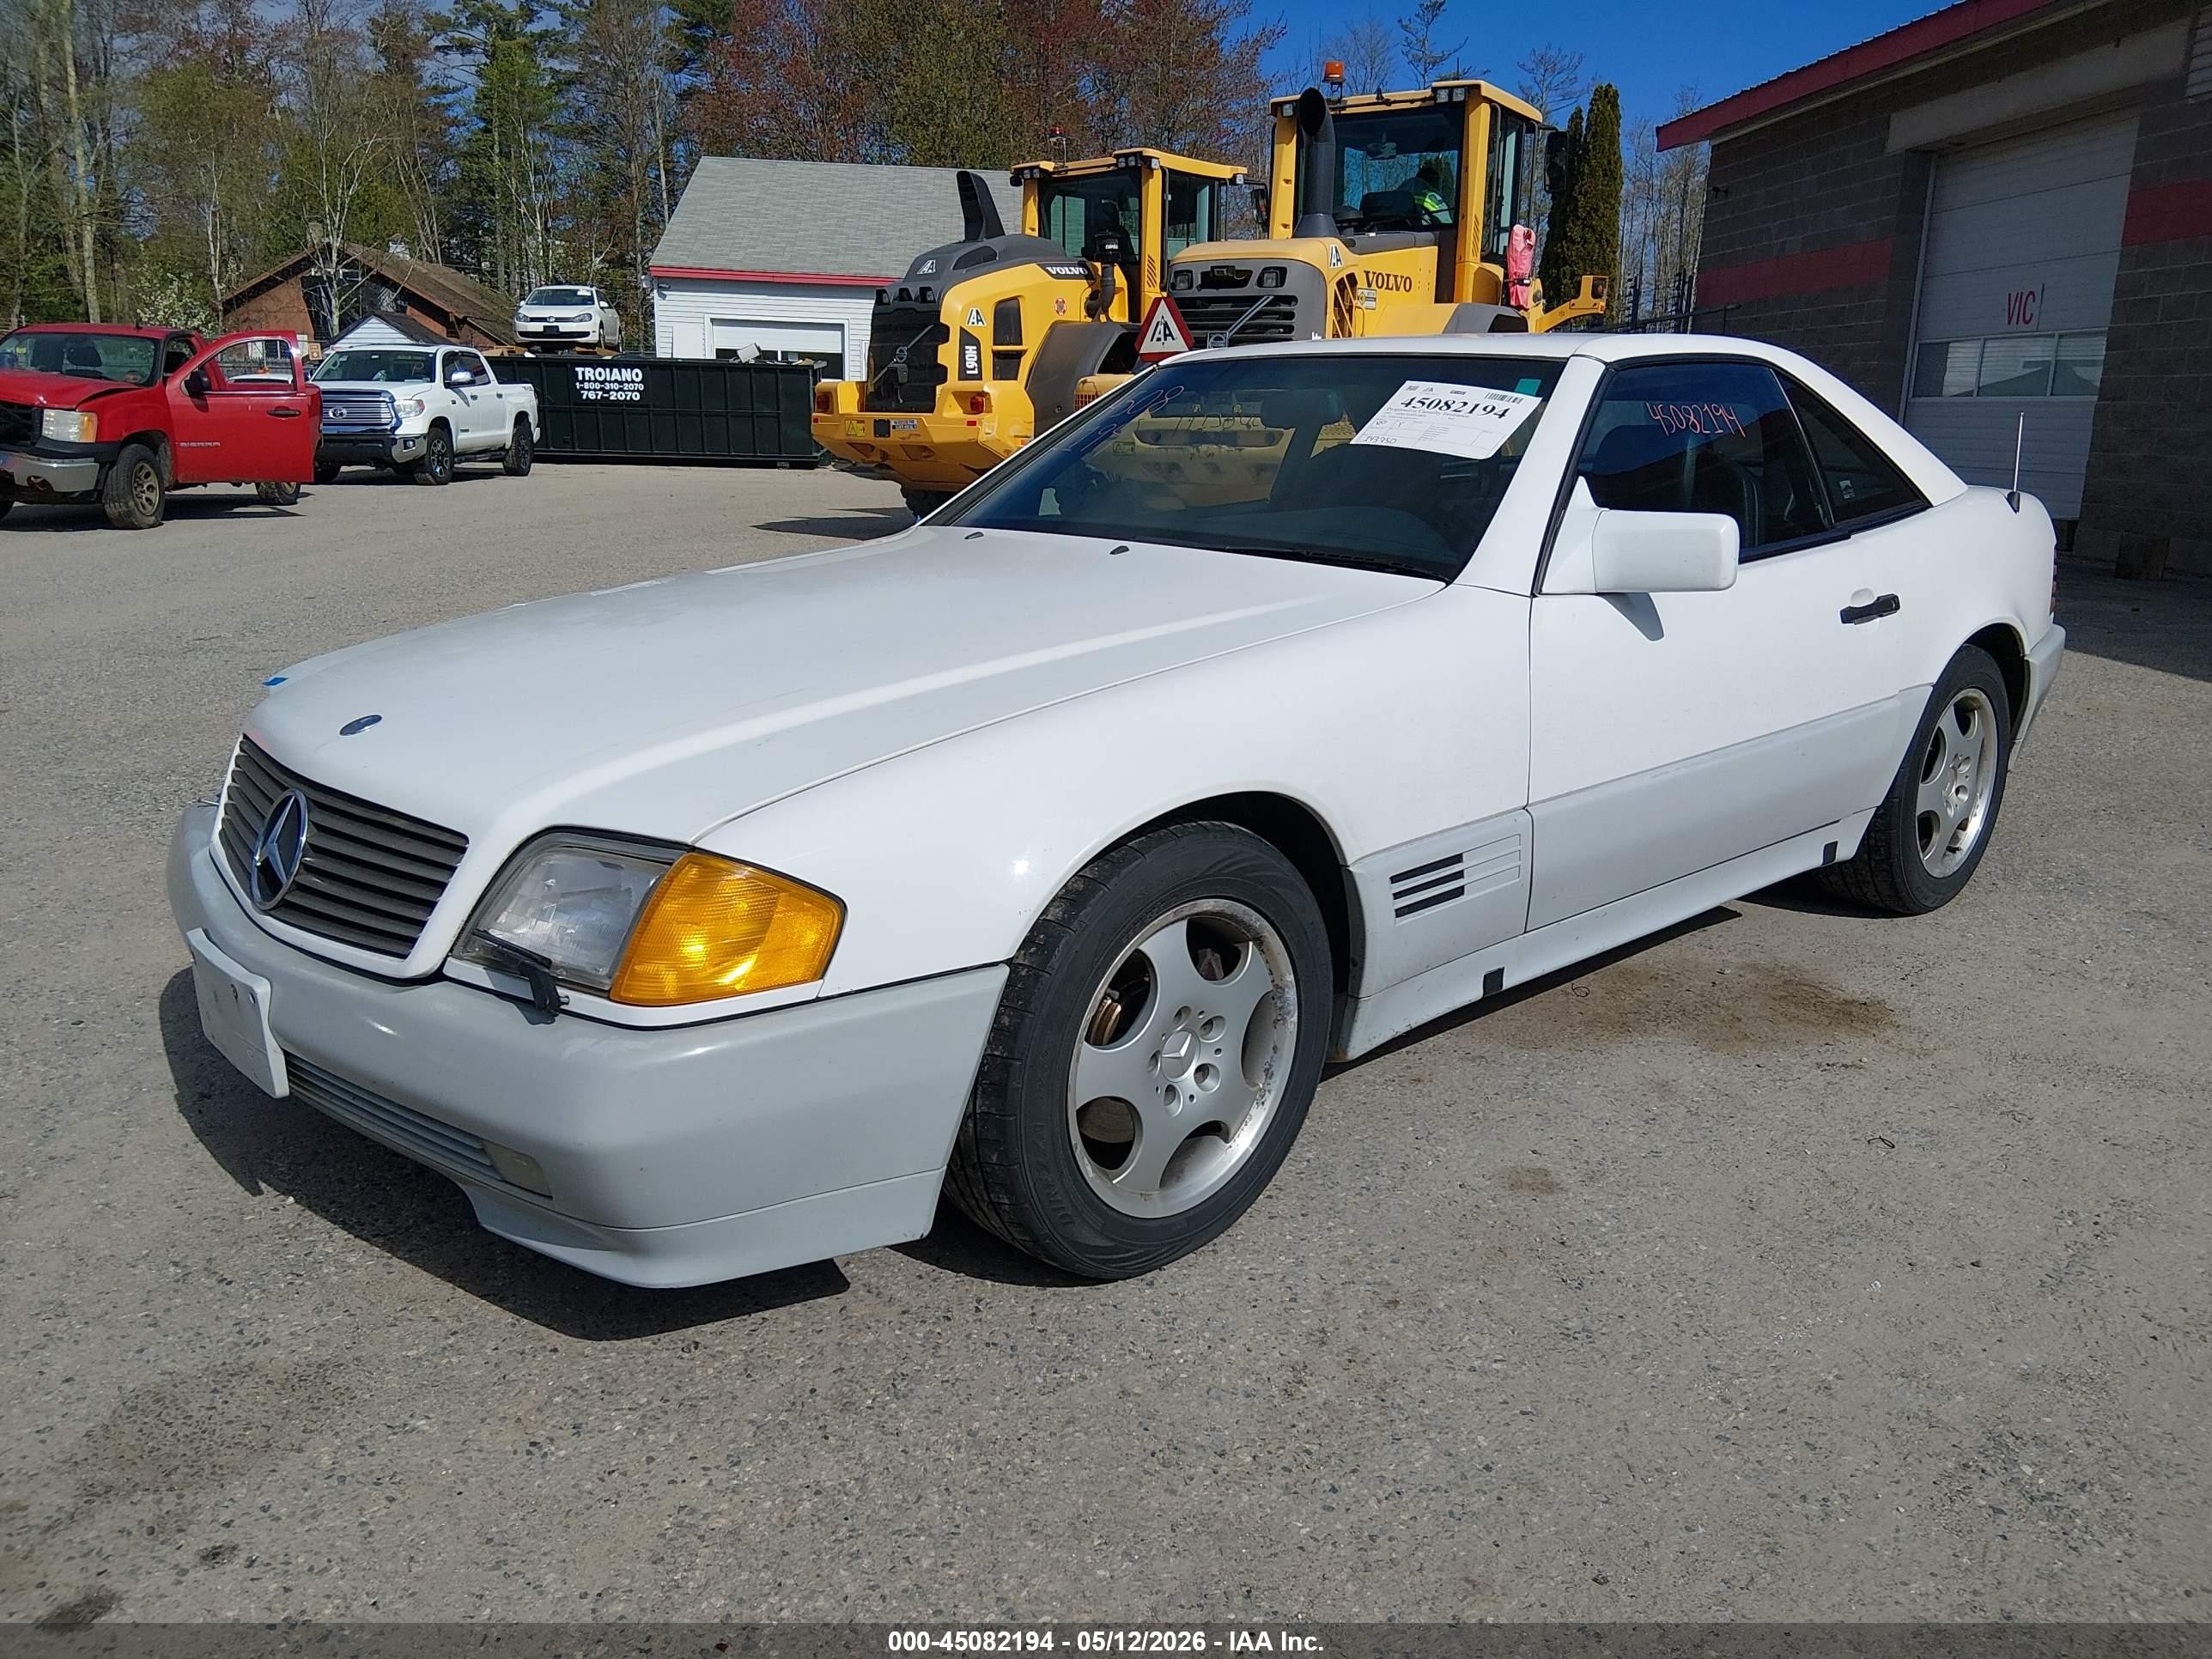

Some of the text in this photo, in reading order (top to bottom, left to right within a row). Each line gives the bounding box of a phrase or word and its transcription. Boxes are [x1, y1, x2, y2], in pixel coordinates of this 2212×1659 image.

[1045, 266, 1089, 276] VOLVO
[1363, 270, 1413, 293] VOLVO
[574, 367, 643, 383] TROIANO
[575, 381, 645, 392] 1-800-310-2070
[580, 390, 641, 401] 767-2070
[1401, 395, 1511, 420] 45082194
[1645, 401, 1747, 438] 45082194
